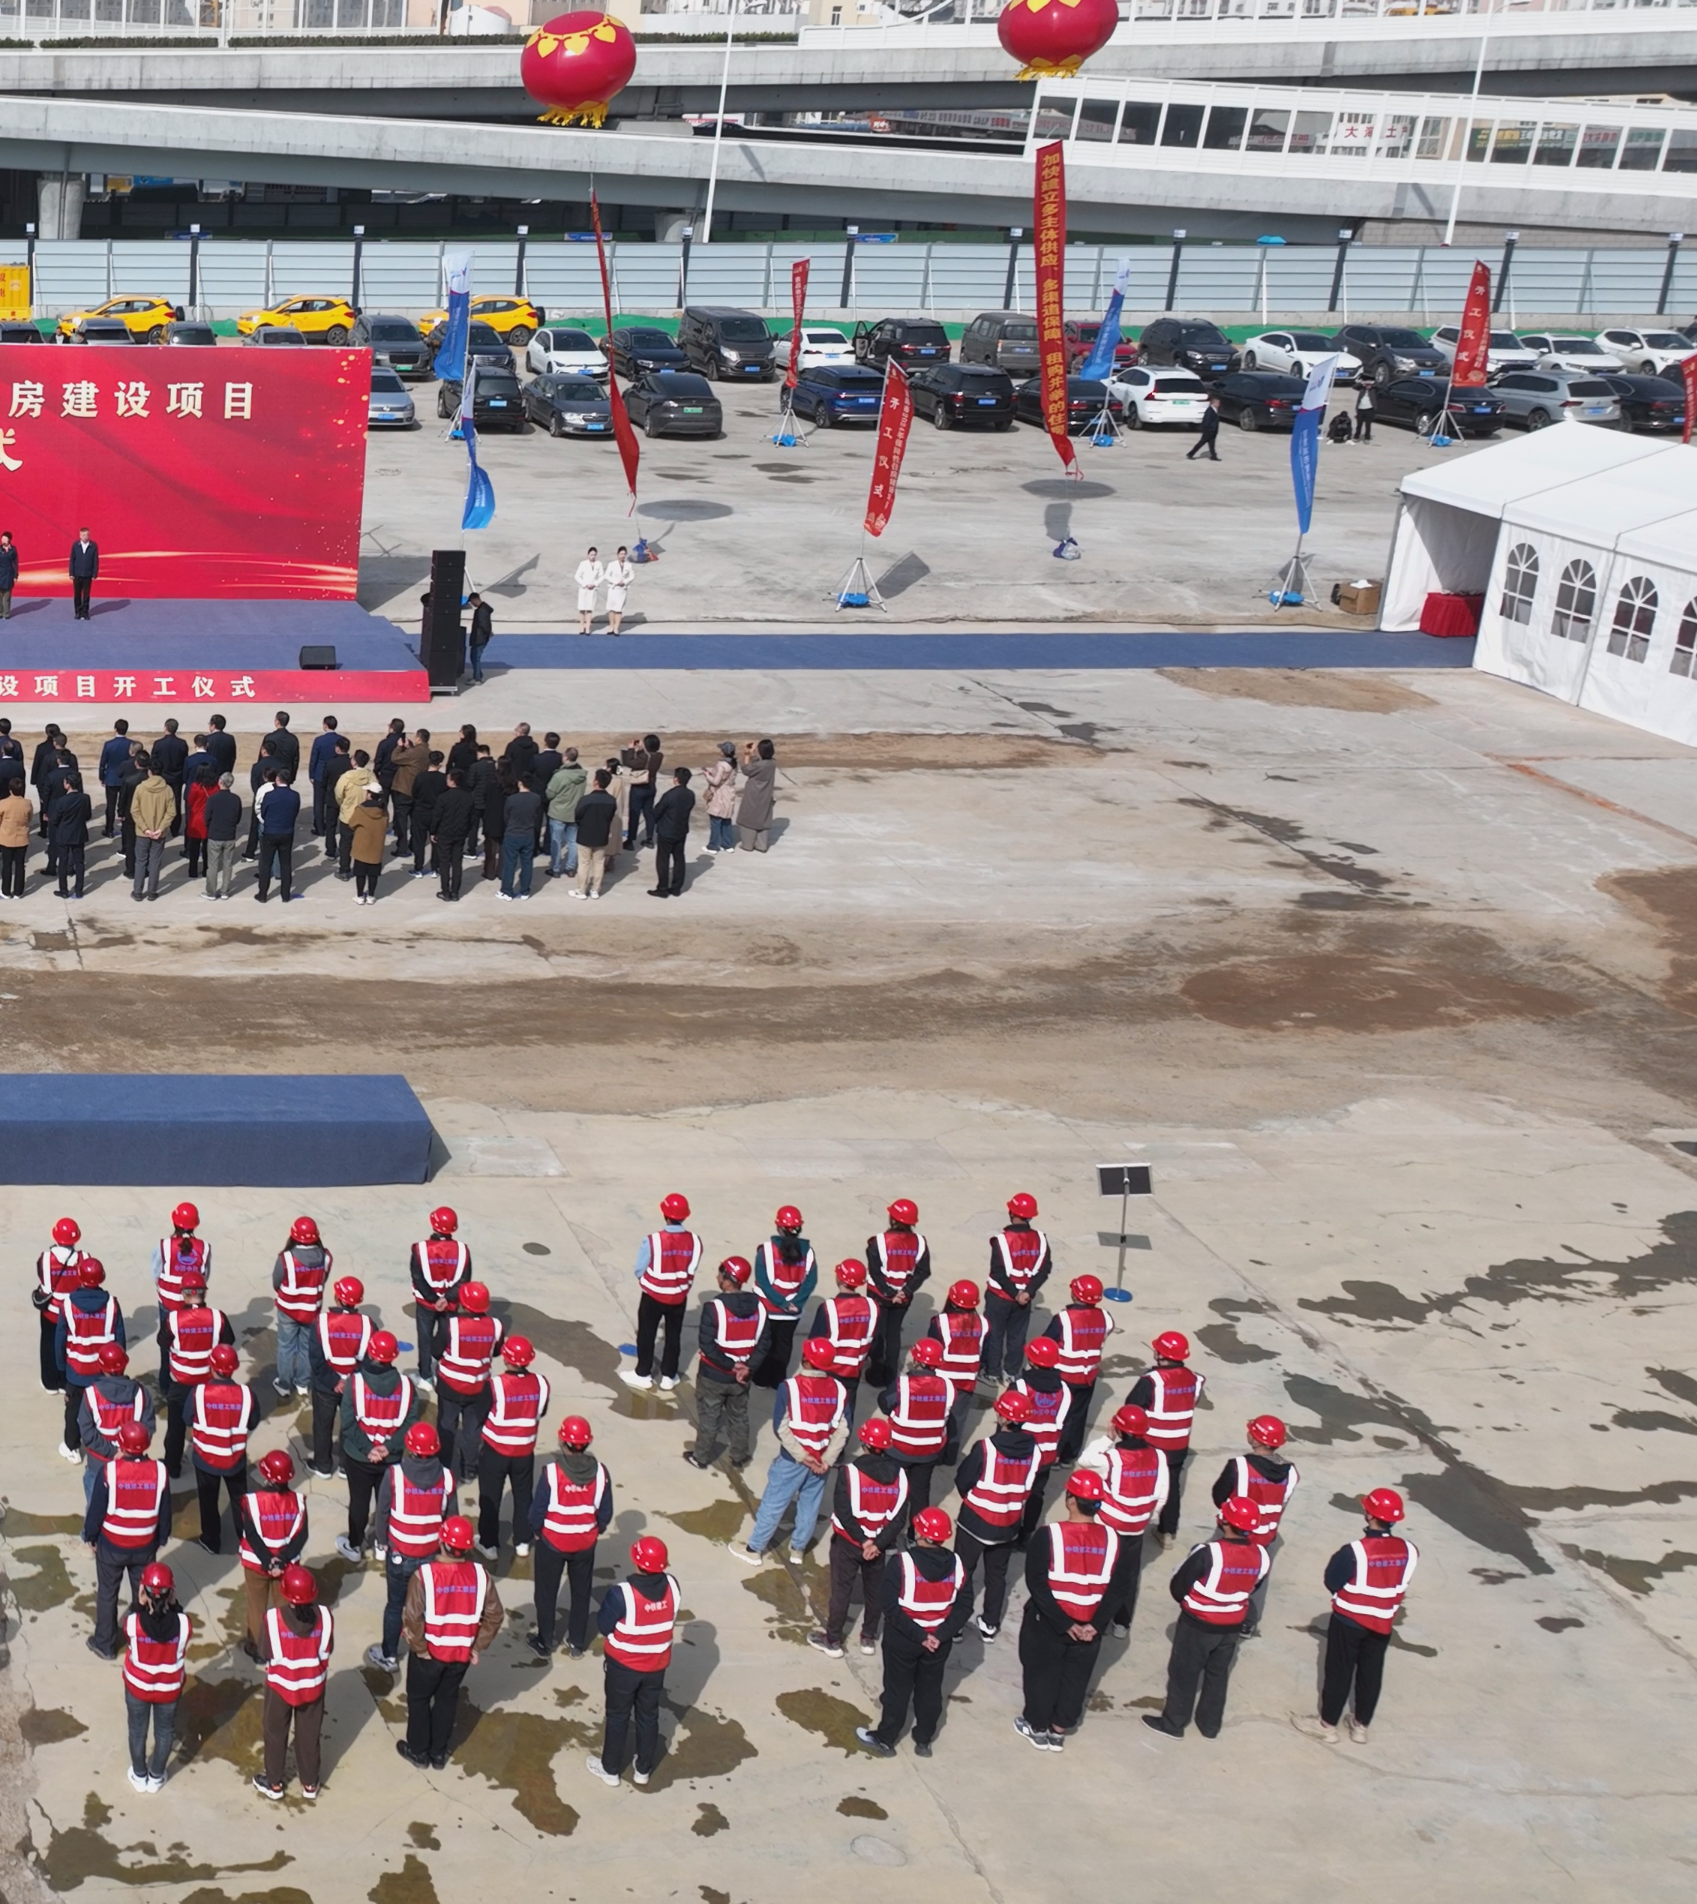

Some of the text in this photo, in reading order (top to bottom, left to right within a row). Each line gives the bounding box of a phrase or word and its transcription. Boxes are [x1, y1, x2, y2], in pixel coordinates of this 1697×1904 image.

[1457, 285, 1486, 362] 开工仪式
[873, 396, 900, 499] 开工仪式
